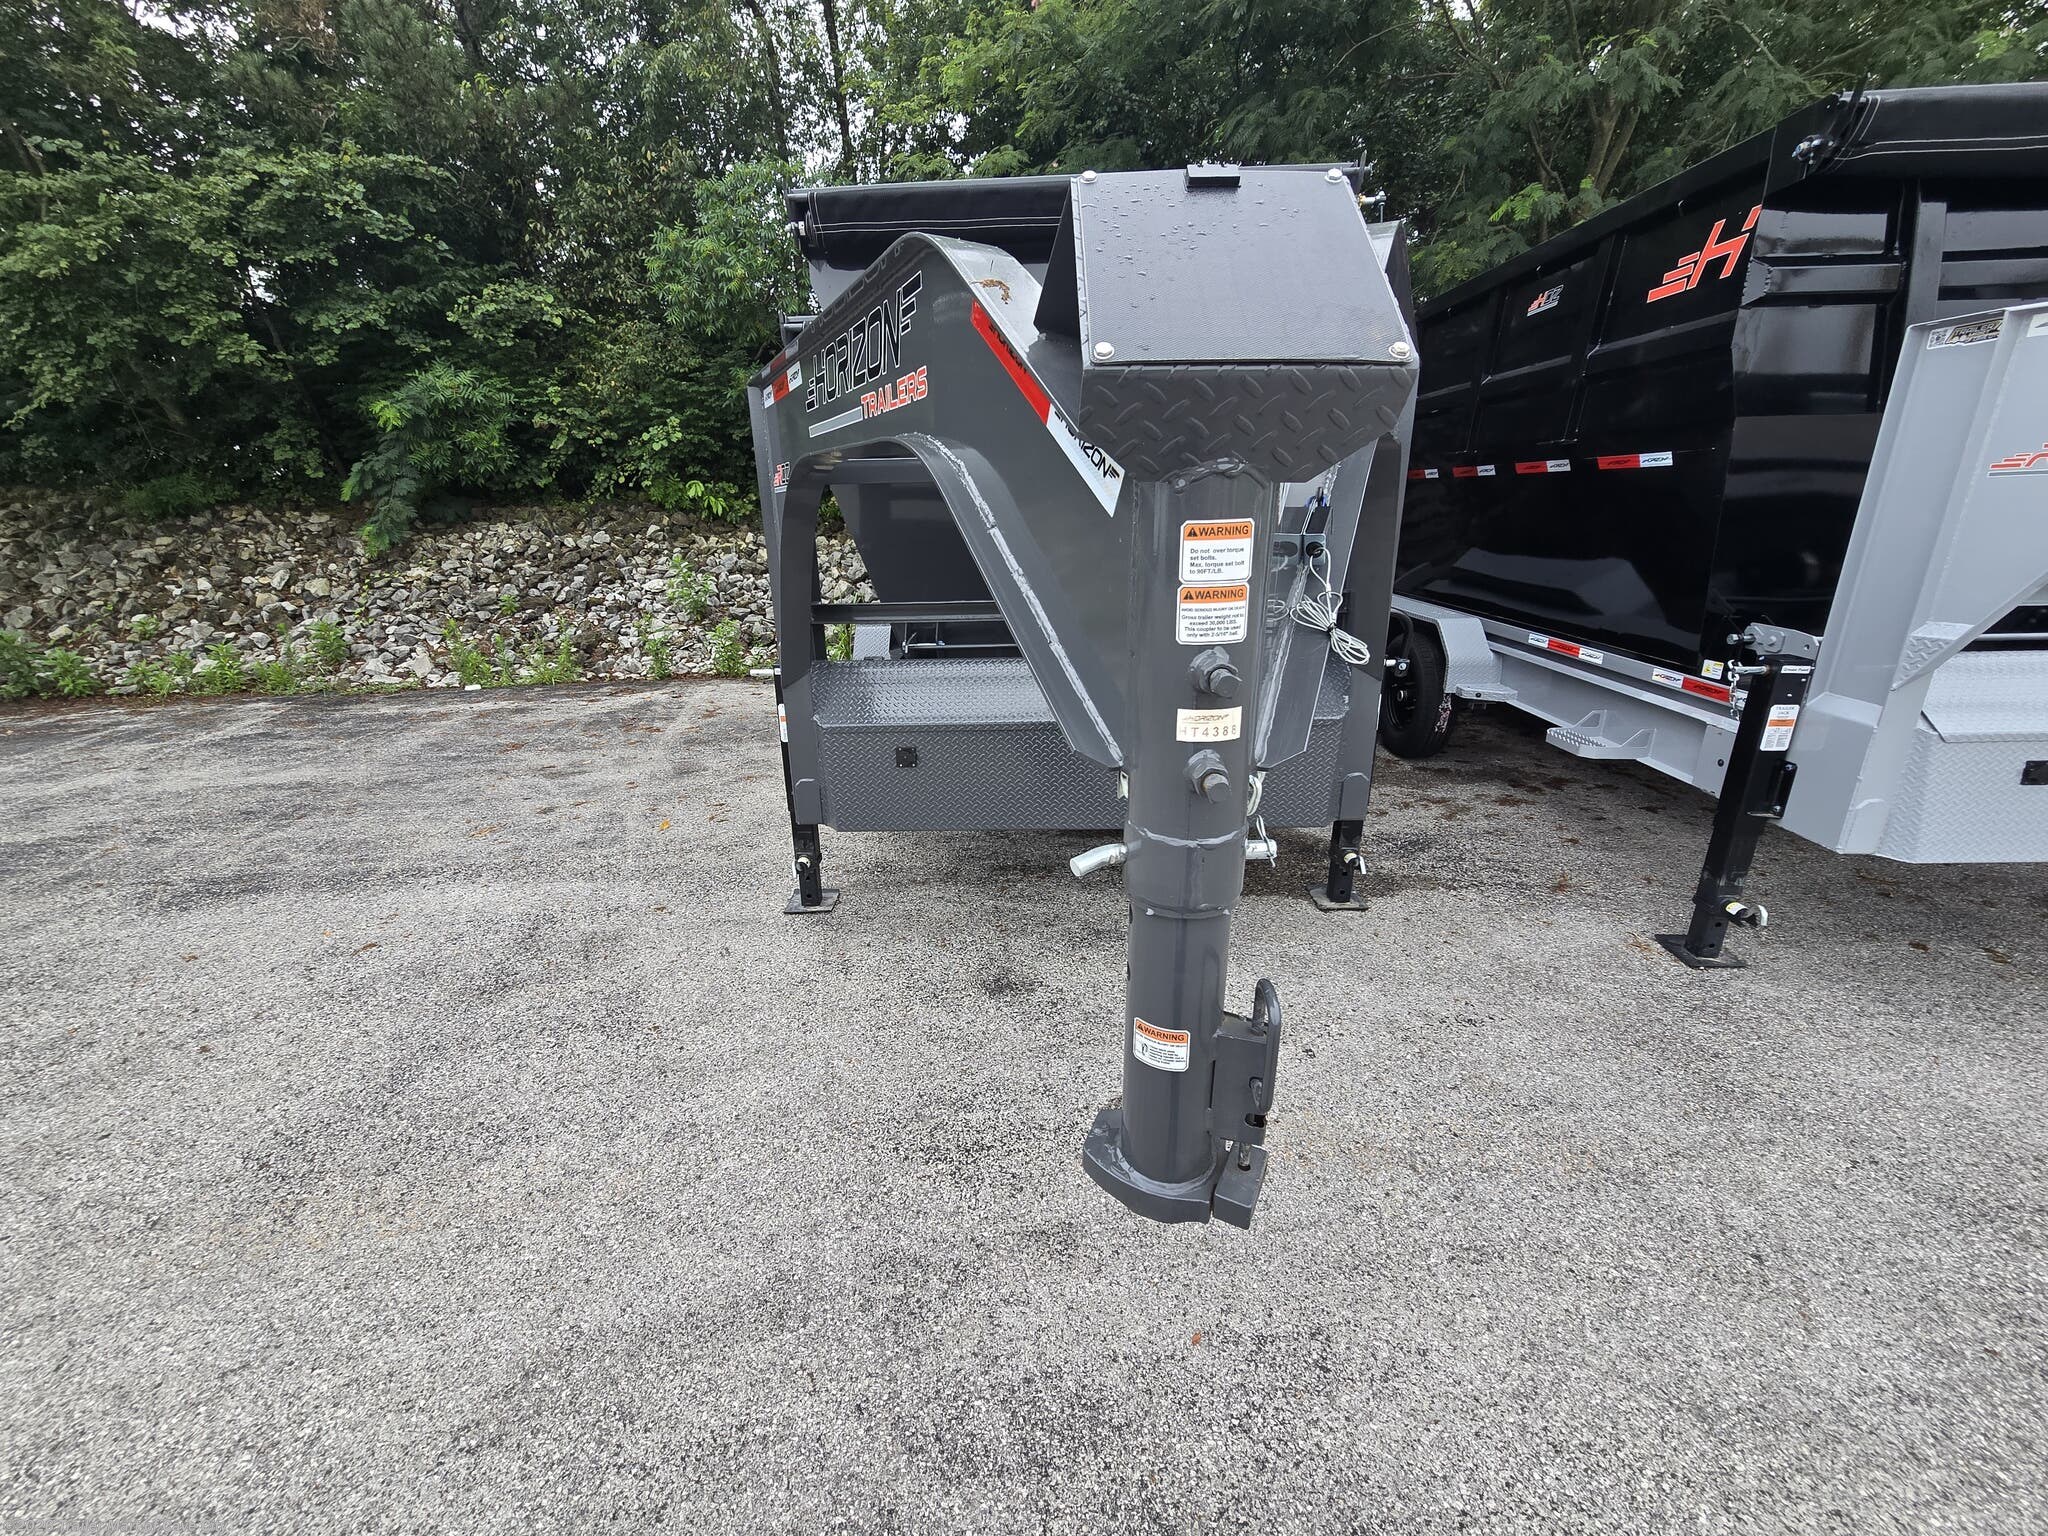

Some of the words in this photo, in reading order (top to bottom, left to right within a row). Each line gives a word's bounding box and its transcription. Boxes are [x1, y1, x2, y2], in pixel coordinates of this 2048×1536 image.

[806, 273, 920, 411] HORIZON
[861, 365, 928, 420] TRAILERS
[1199, 525, 1249, 537] WARNING
[1194, 588, 1244, 600] WARNING
[1143, 1026, 1185, 1042] WARNING
